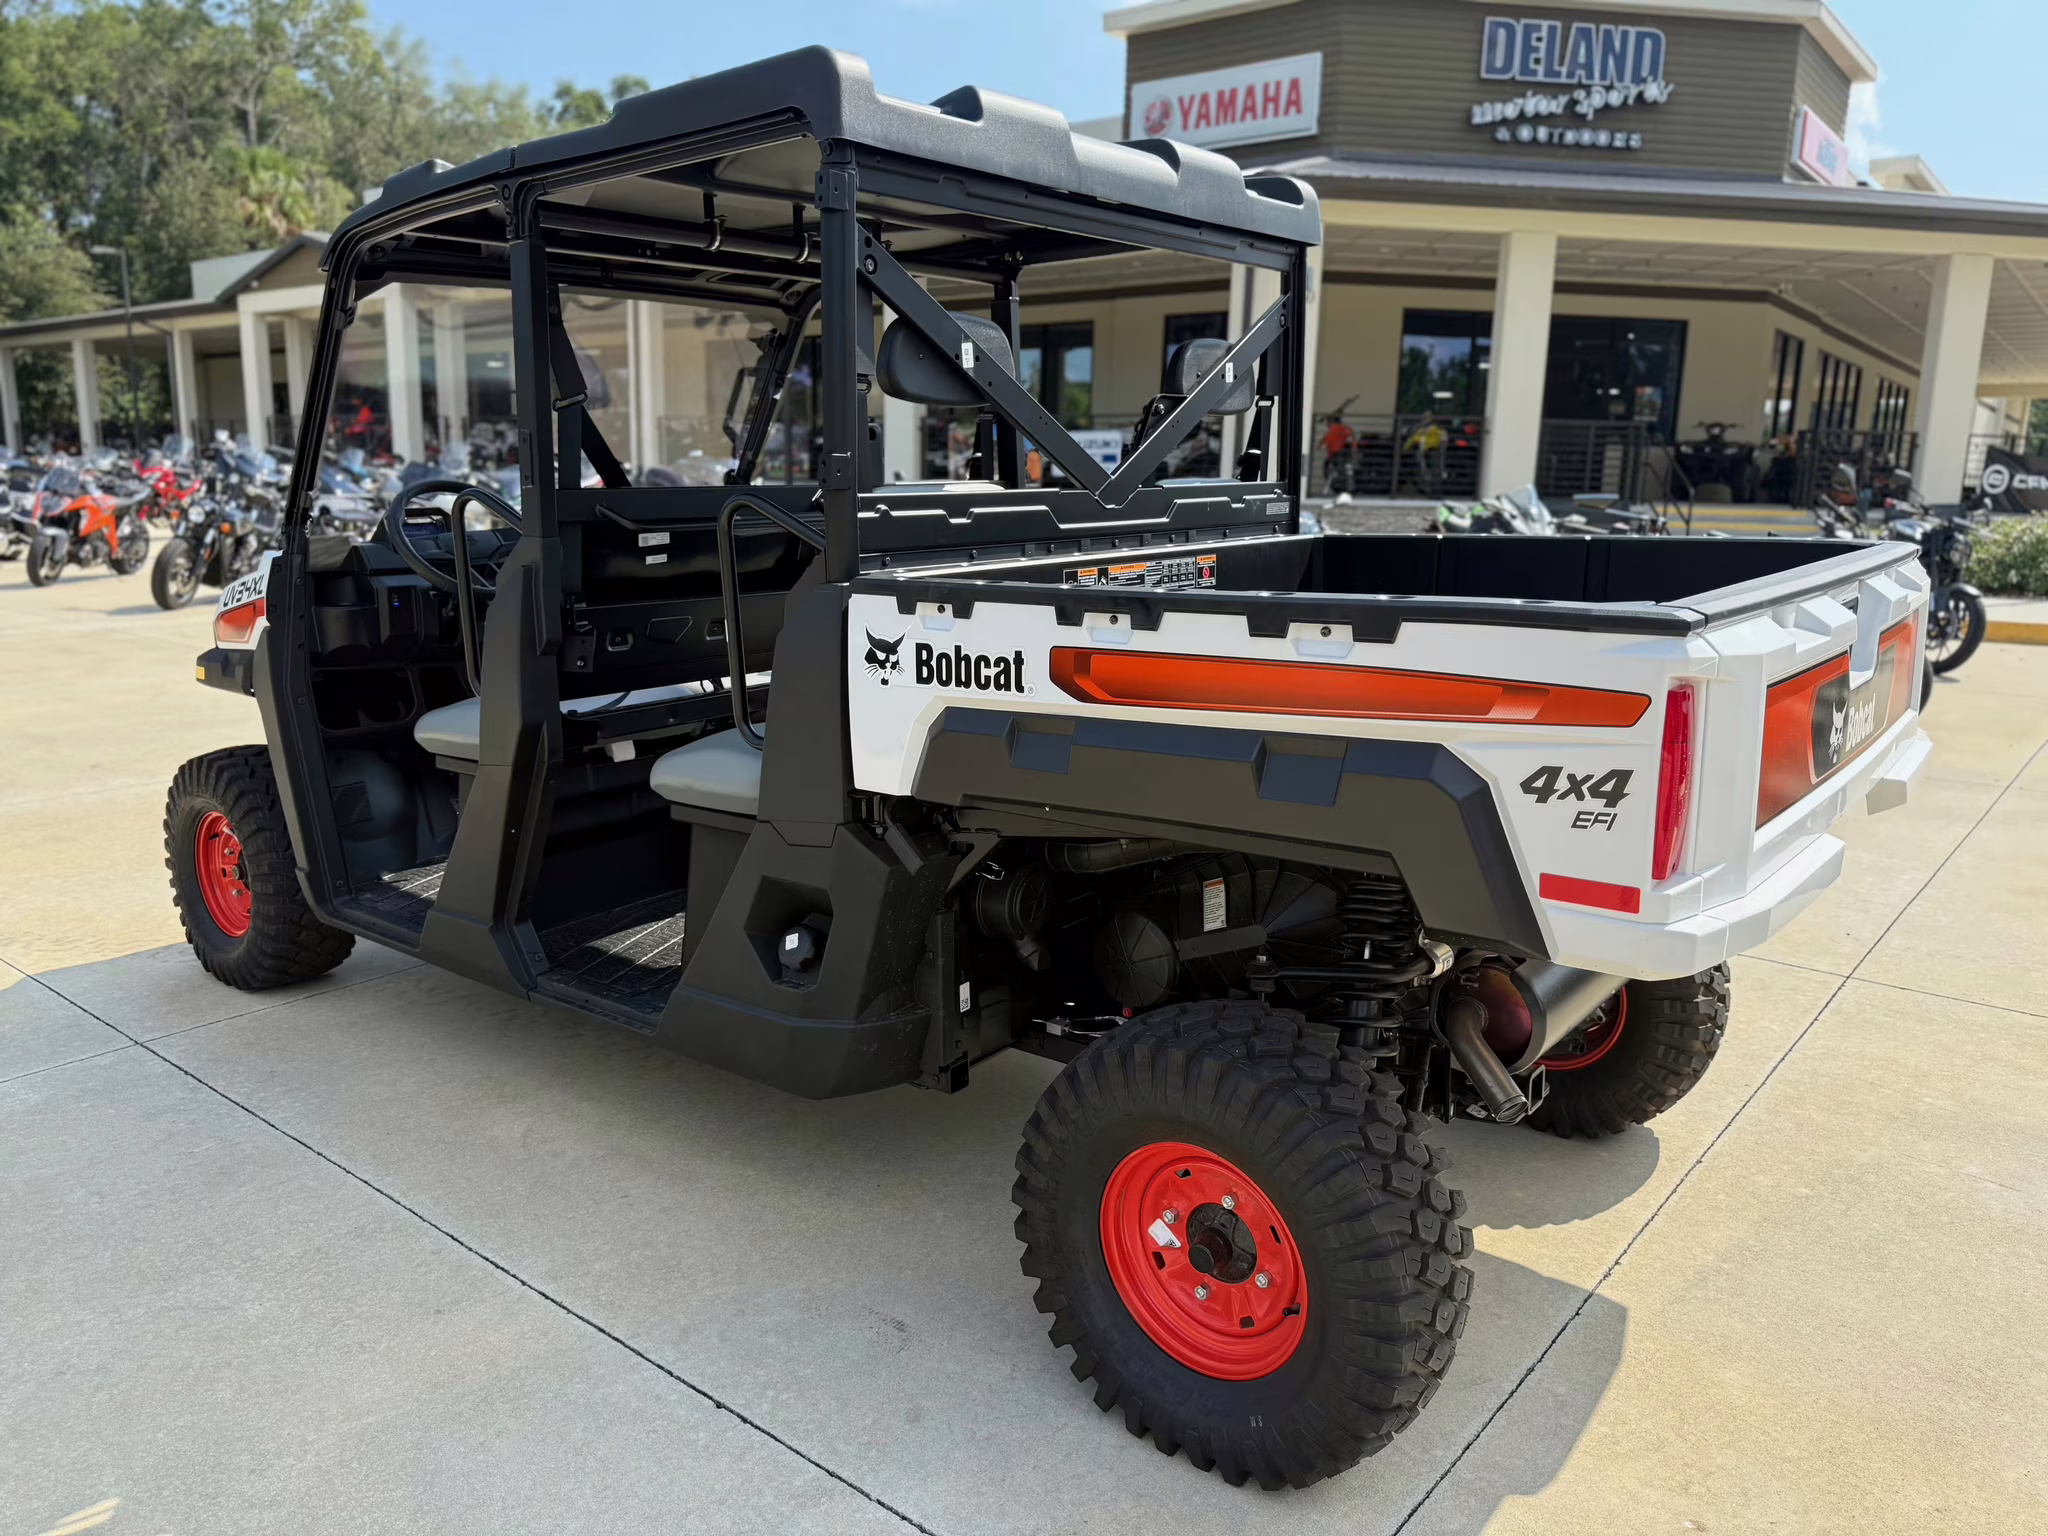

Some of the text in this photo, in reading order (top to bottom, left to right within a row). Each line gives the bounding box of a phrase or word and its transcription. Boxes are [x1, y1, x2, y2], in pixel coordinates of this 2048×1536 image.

[1480, 16, 1666, 86] DELAND
[1178, 77, 1303, 132] YAMAHA
[223, 574, 265, 607] UV34XL
[915, 642, 1025, 693] Bobcat
[1845, 693, 1876, 752] Bobcat
[1519, 765, 1635, 809] 4x4
[1570, 811, 1619, 832] EFI
